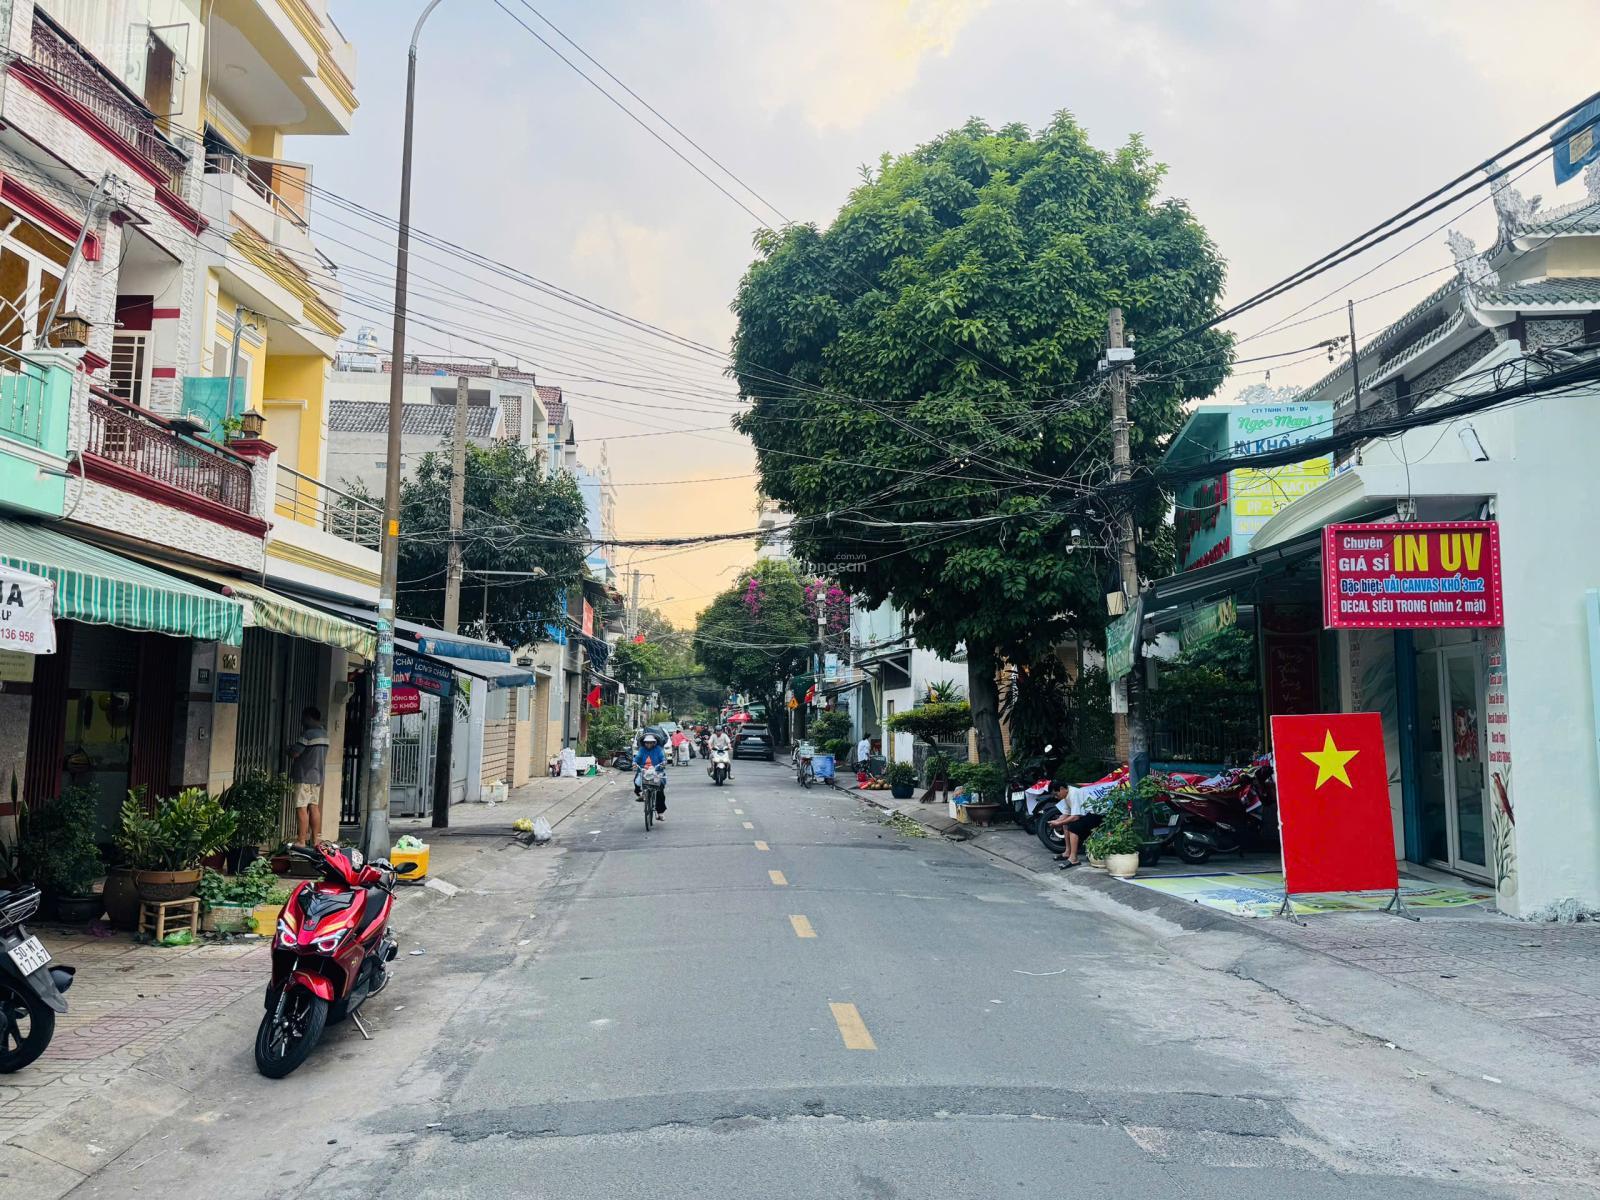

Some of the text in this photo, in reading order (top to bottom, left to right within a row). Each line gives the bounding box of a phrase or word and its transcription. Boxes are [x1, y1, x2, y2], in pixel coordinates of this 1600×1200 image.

[1338, 553, 1390, 572] GIÁ SỈ
[1343, 533, 1482, 572] Chuyên IN UV
[1340, 578, 1360, 596] Đặc
[1383, 574, 1401, 593] VẢI
[1401, 577, 1440, 593] CANVAS
[1440, 572, 1462, 593] KHỔ
[1462, 577, 1485, 593] 3m2
[1340, 597, 1486, 615] DECAL SIÊU TRONG (nhìn 2 mặt)
